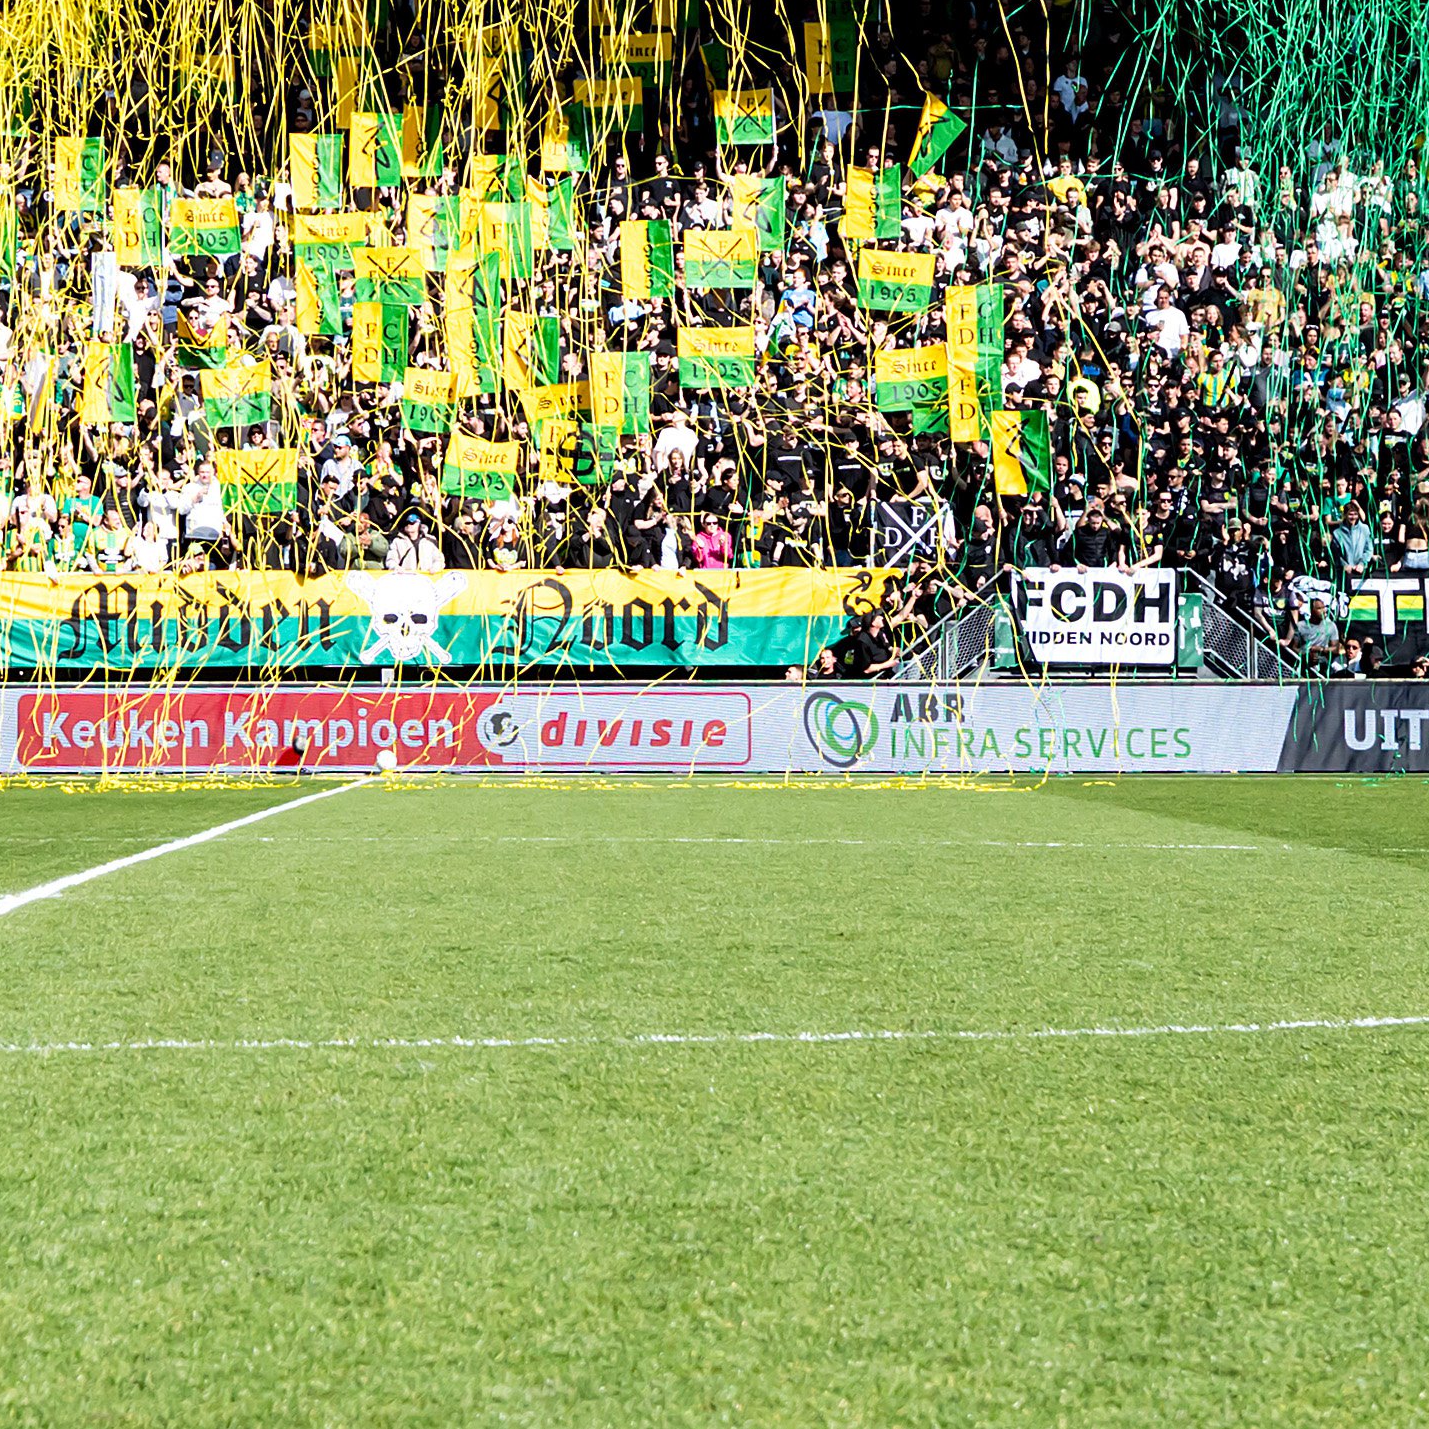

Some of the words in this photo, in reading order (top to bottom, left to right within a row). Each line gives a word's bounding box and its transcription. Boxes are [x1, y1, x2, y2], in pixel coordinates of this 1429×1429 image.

[872, 261, 916, 277] Since
[870, 285, 916, 302] 1905
[366, 323, 398, 341] FC
[364, 347, 398, 365] DH
[892, 360, 937, 374] Since
[891, 380, 942, 401] 1905
[462, 449, 508, 465] Since
[1017, 581, 1170, 623] FCDH
[1100, 632, 1170, 646] NOORD
[890, 694, 964, 723] ABR
[43, 710, 209, 749] Keuken
[224, 710, 455, 759] Kampioen
[541, 712, 727, 748] divisie
[891, 728, 1000, 759] INFRA
[1014, 728, 1191, 759] SERVICES
